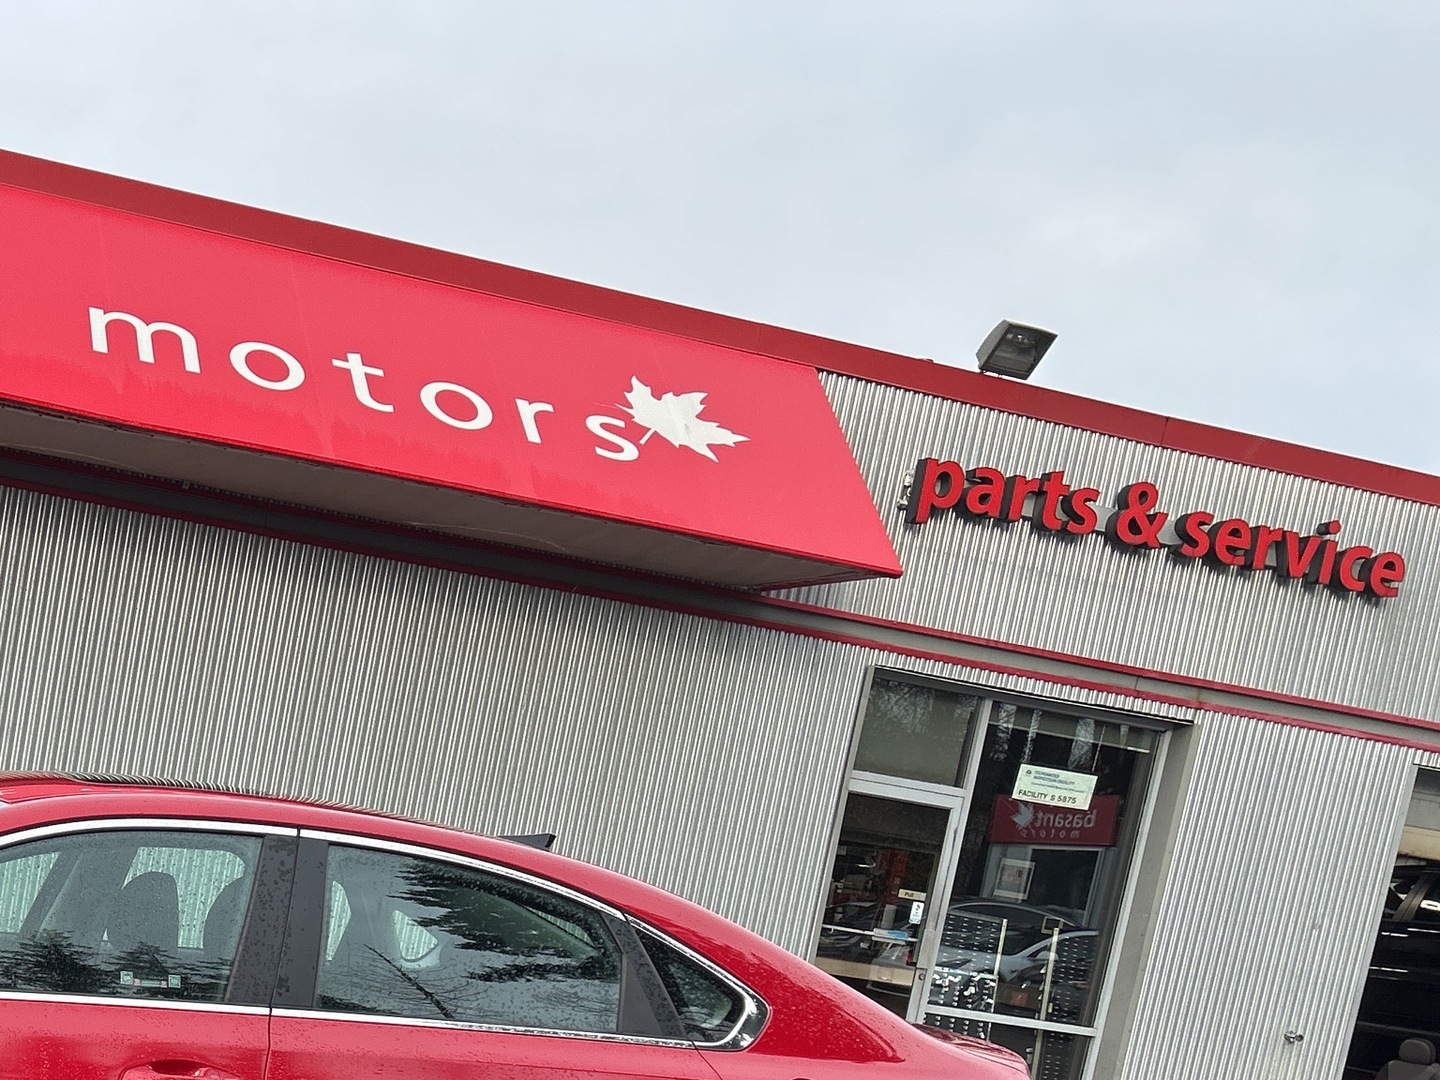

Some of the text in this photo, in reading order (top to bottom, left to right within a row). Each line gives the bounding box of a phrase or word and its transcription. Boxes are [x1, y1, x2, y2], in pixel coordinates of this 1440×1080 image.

[88, 306, 640, 462] motors
[910, 457, 1406, 598] parts & service
[1018, 789, 1048, 800] FACILITY
